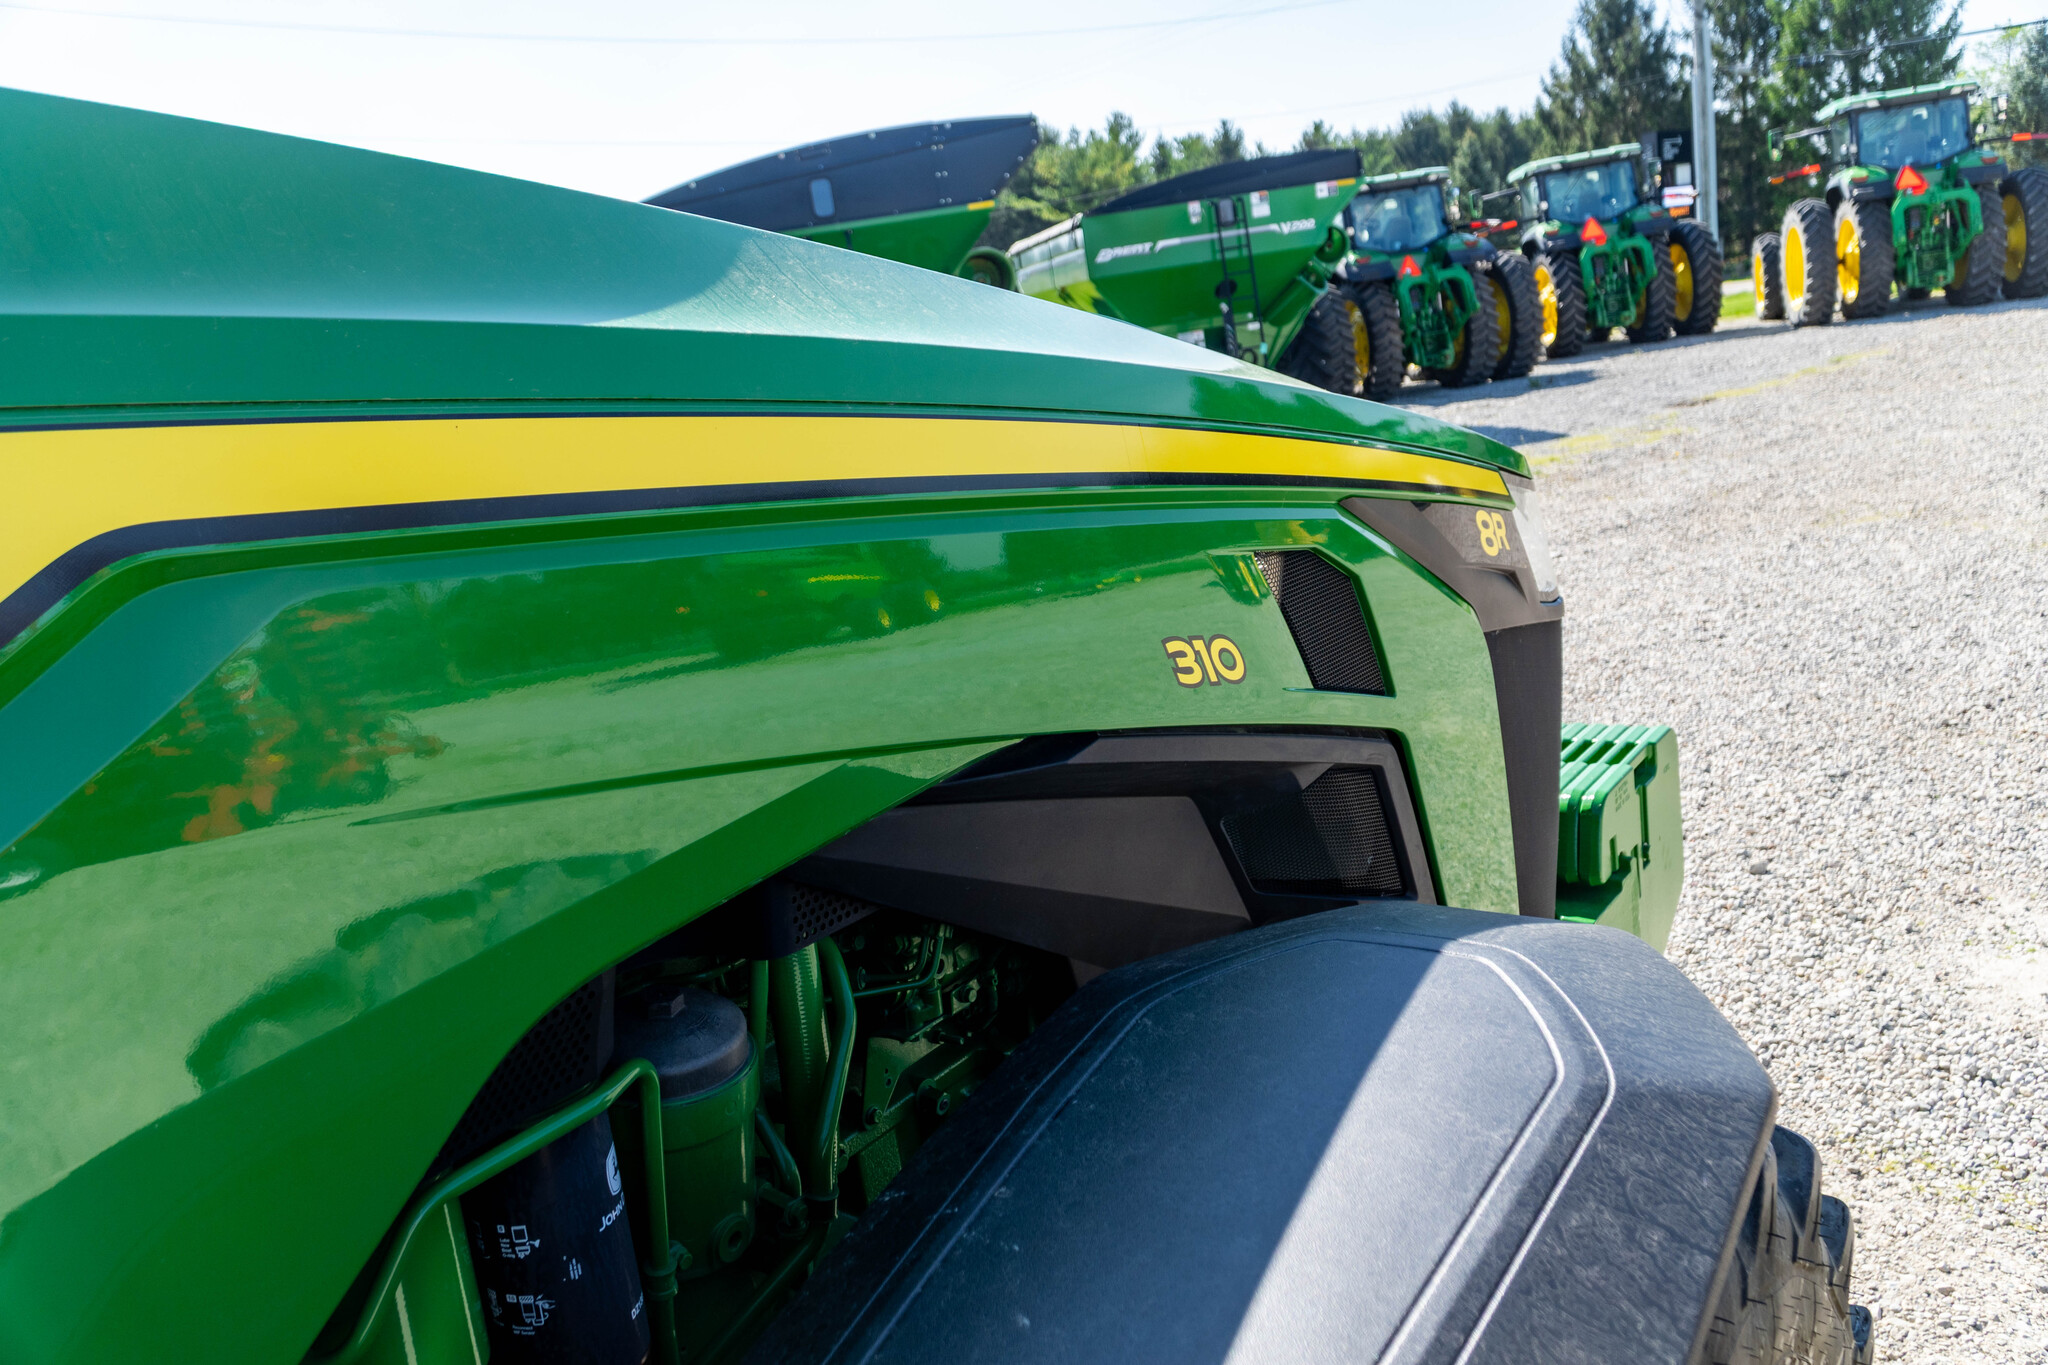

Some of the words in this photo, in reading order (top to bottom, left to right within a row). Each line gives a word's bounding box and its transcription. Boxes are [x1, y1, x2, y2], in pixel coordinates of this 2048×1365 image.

[1475, 509, 1511, 557] 8R
[1161, 633, 1247, 689] 310
[599, 1200, 623, 1232] JOHN
